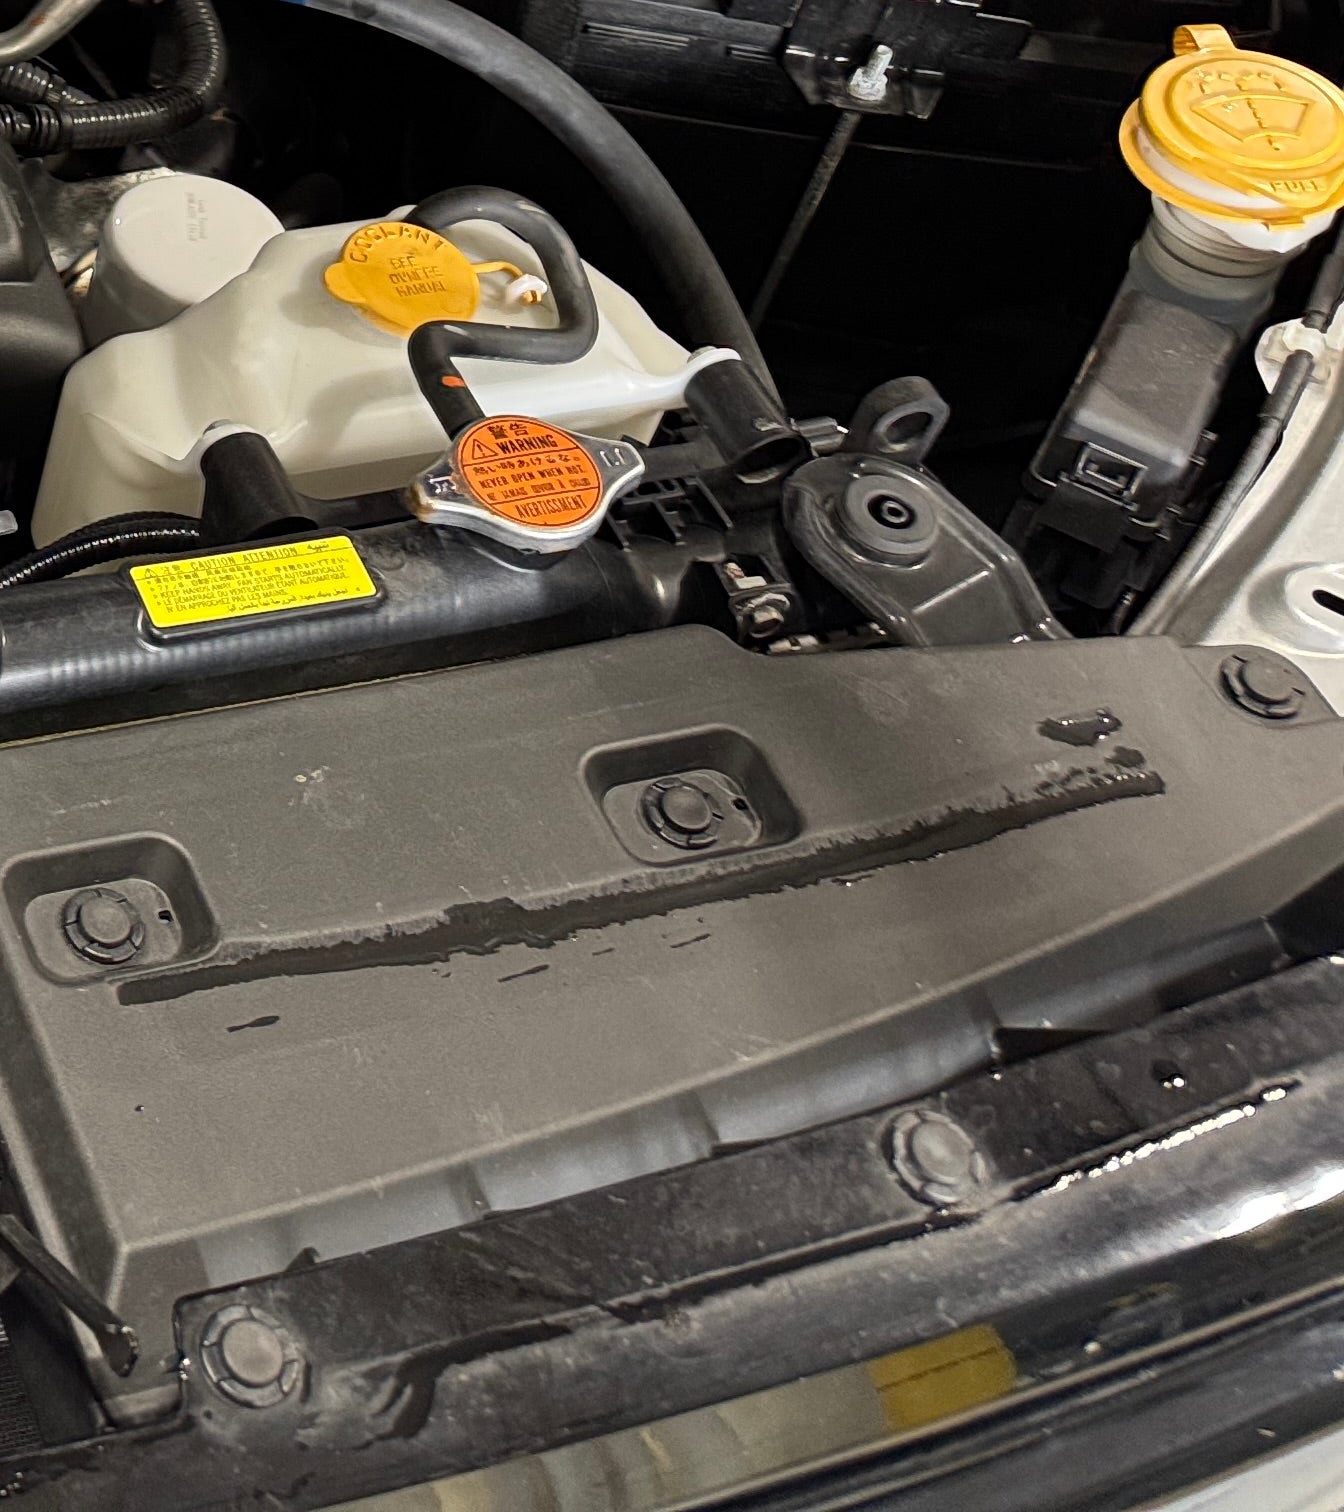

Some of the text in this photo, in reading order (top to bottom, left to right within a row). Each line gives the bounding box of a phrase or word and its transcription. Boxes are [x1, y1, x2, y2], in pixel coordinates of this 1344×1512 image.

[349, 225, 447, 263] COOLANT
[496, 434, 558, 456] WARNING
[478, 474, 508, 489] NEVER
[510, 471, 535, 485] OPEN
[537, 466, 564, 480] WHEN
[190, 547, 298, 571] CAUTION ATTENTION
